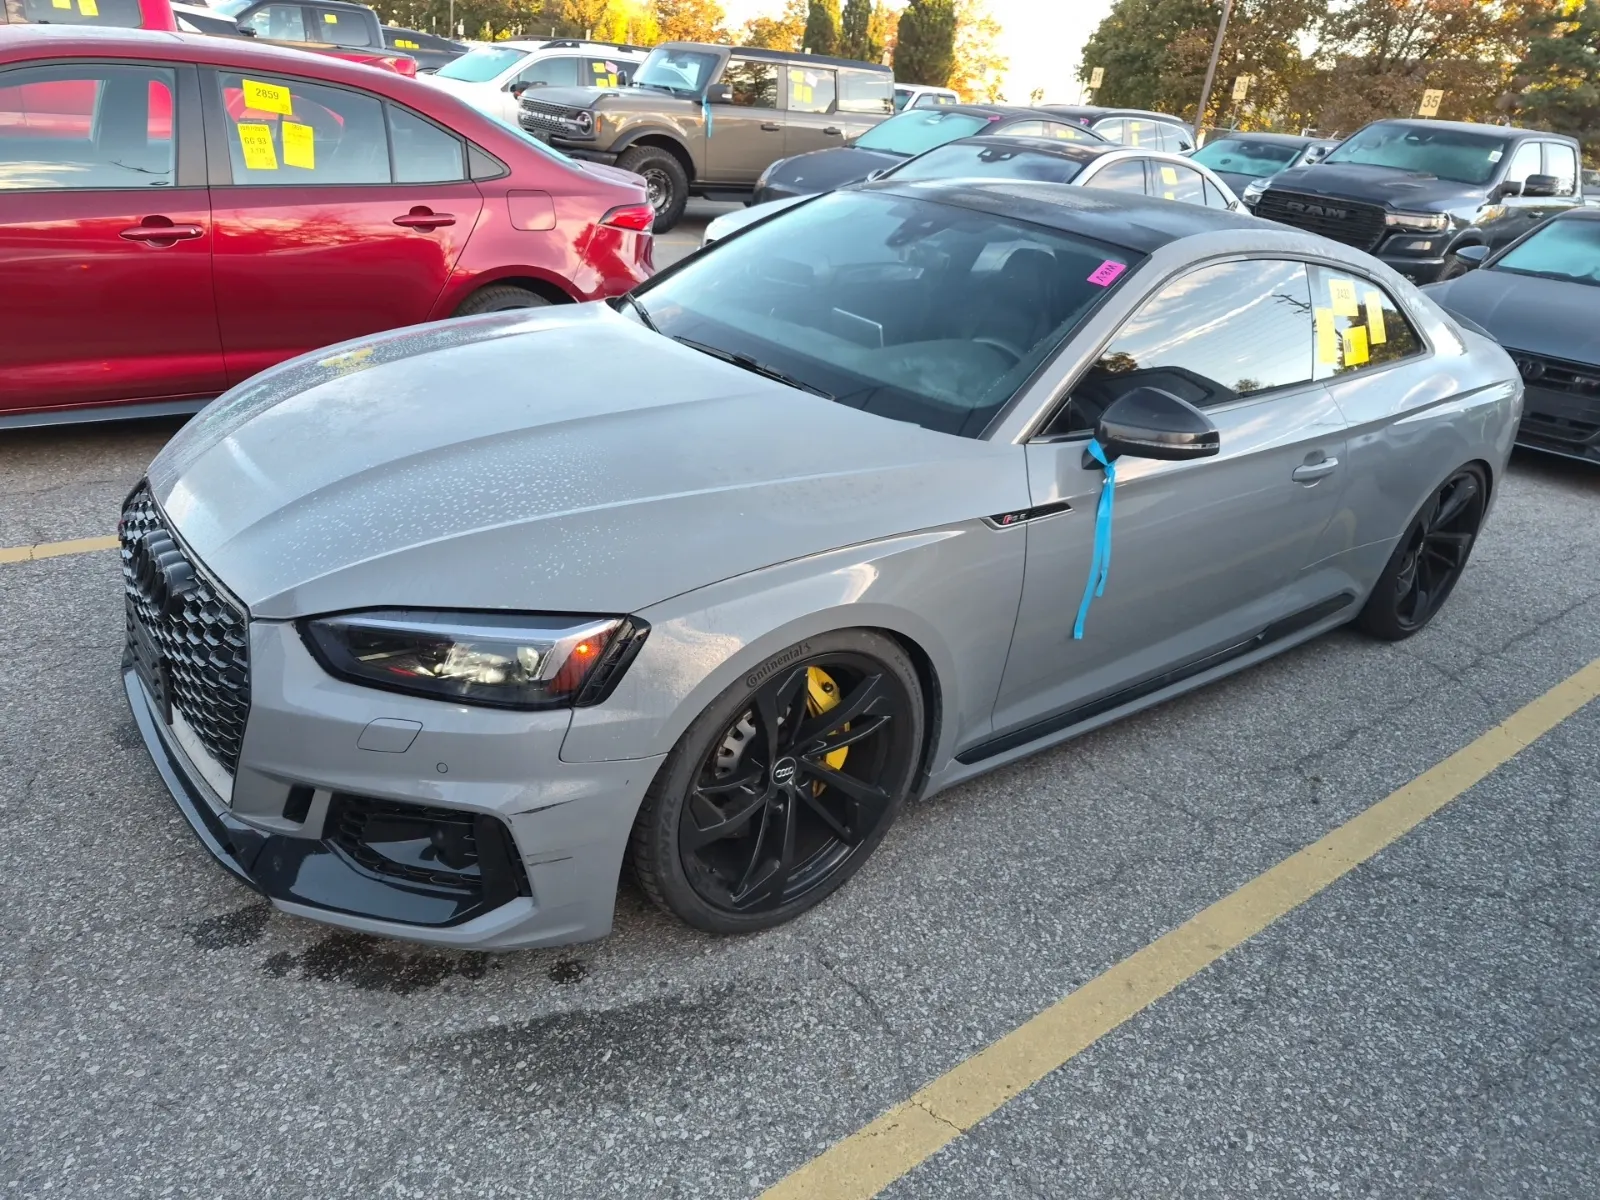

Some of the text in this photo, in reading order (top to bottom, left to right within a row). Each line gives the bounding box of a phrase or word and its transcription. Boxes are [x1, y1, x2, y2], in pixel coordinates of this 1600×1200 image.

[255, 88, 279, 100] 2859
[1423, 94, 1440, 109] 35
[257, 137, 267, 145] 93
[1286, 201, 1347, 219] RAM
[745, 642, 804, 689] Continental
